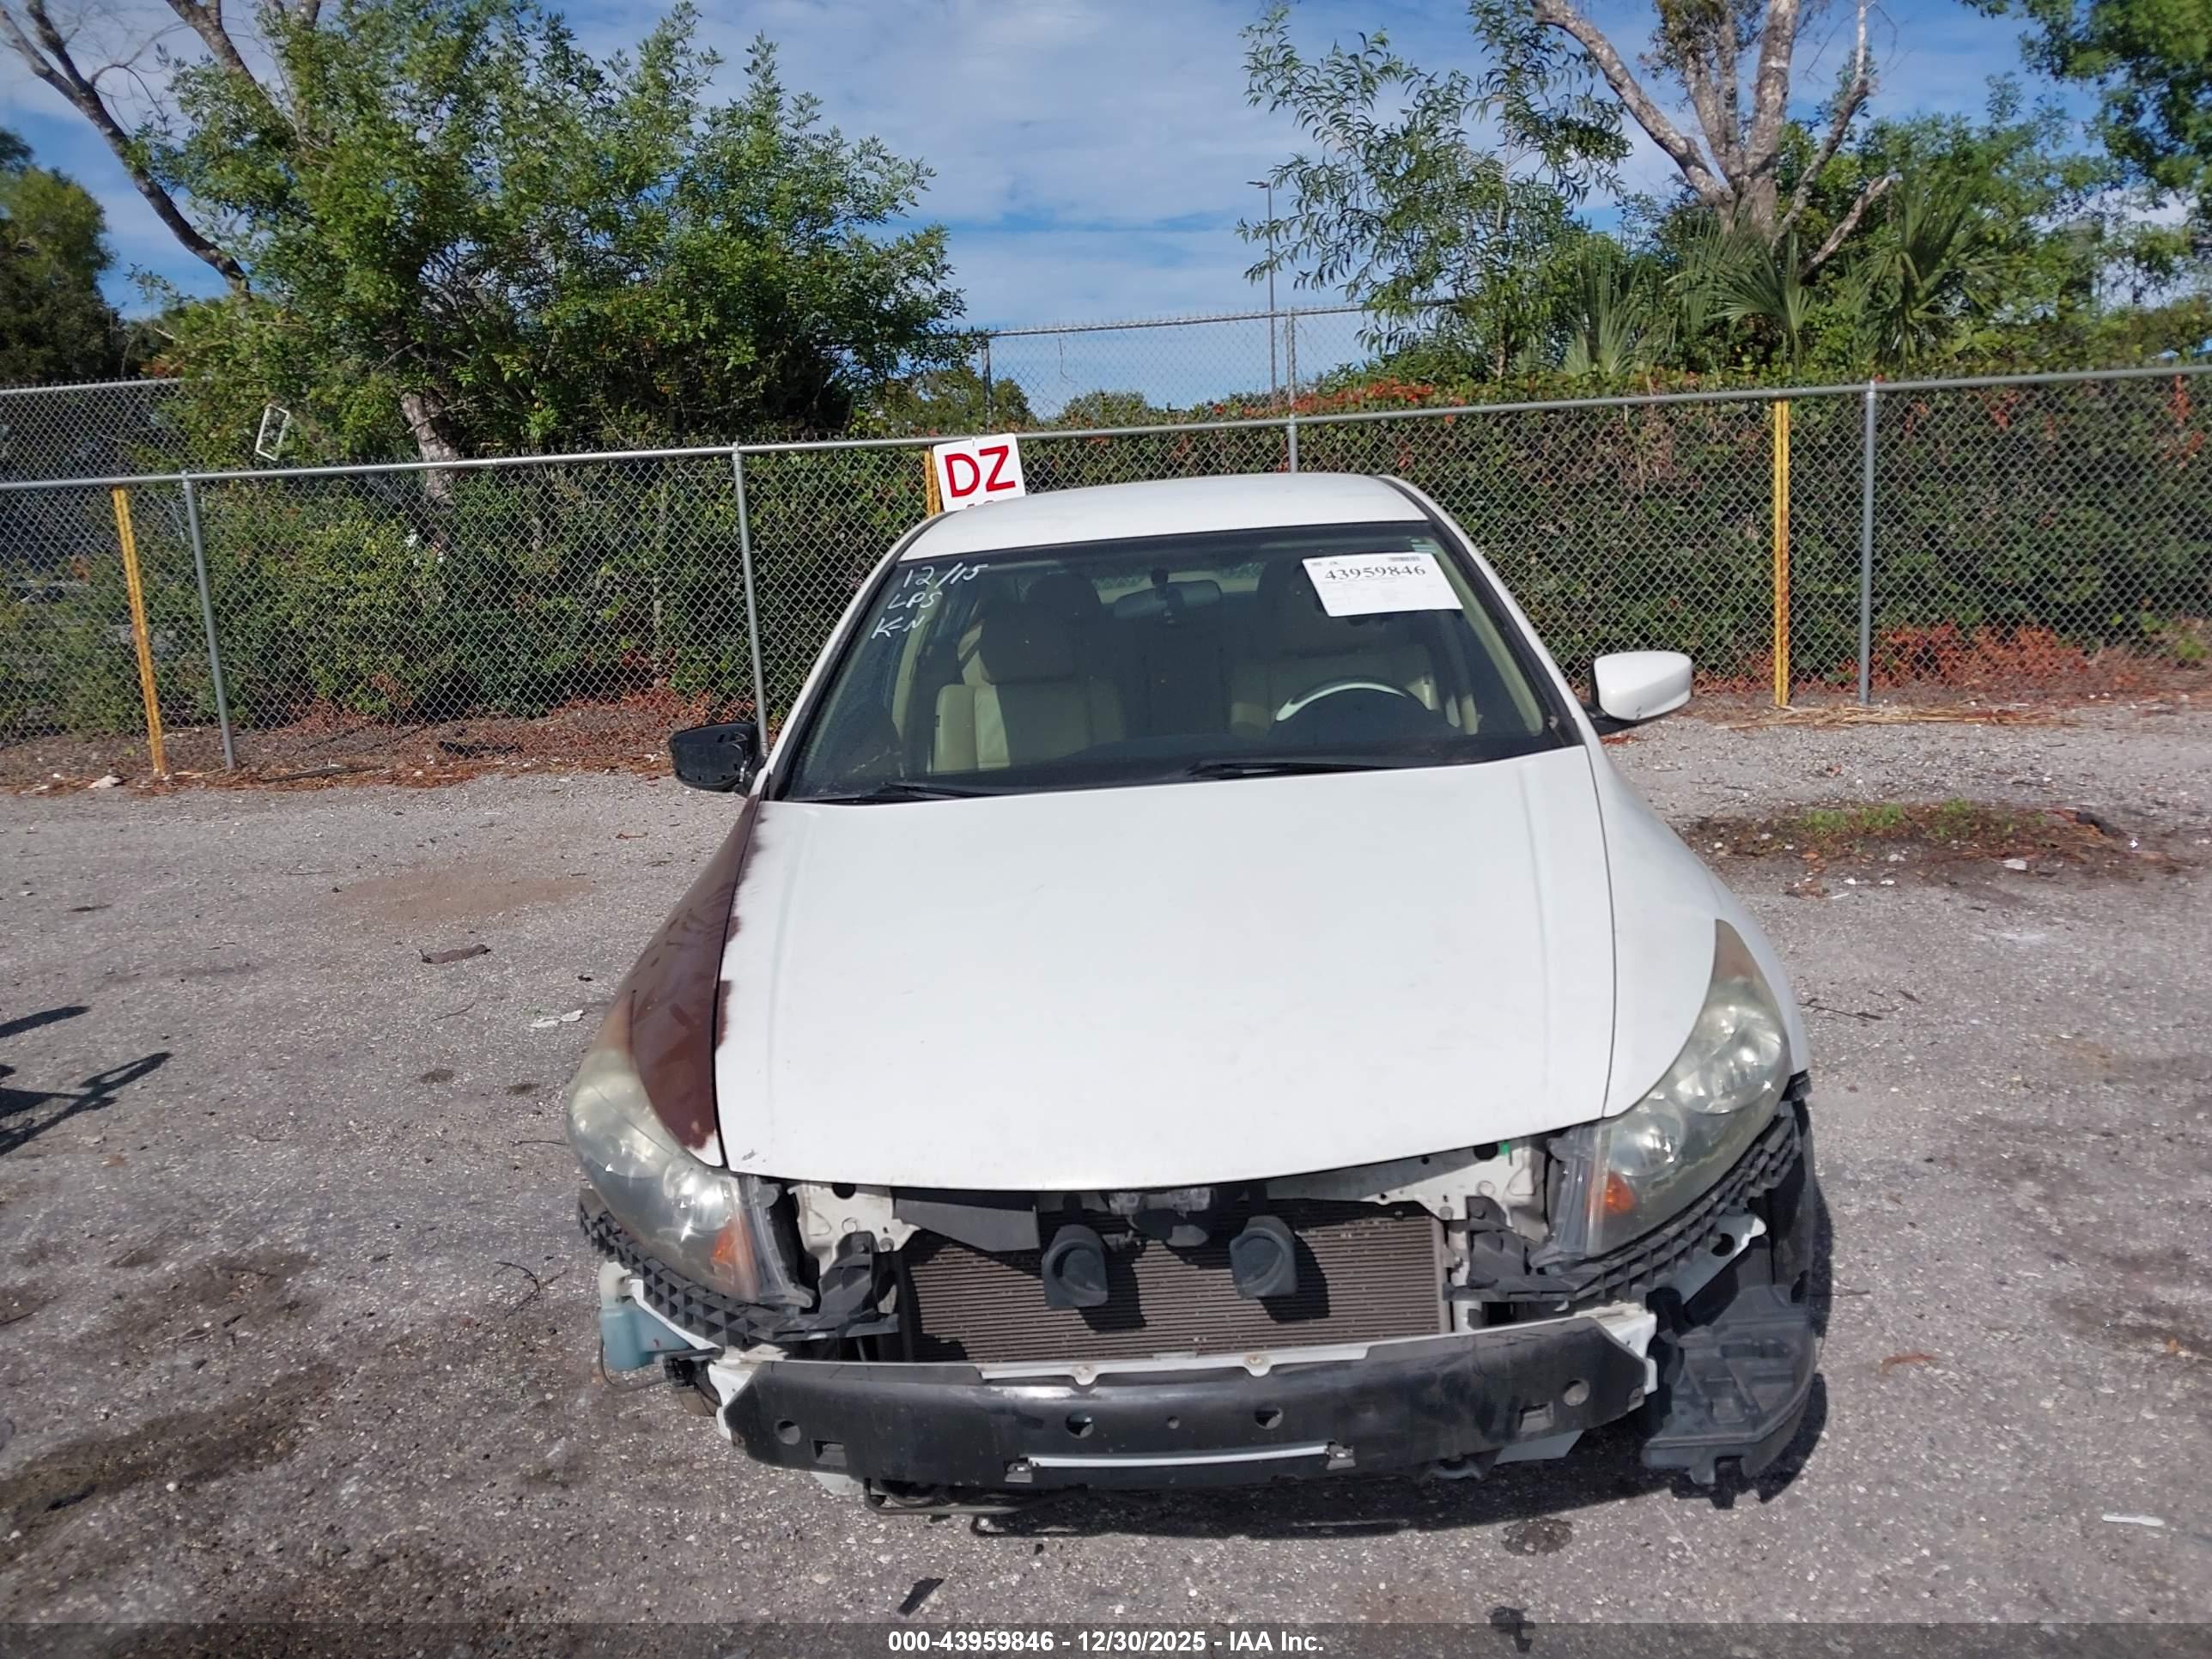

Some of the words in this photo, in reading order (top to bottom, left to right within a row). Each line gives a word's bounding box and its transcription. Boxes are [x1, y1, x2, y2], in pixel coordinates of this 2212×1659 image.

[945, 445, 1017, 498] DZ
[902, 562, 988, 589] 12/15
[1324, 565, 1426, 580] 43959846
